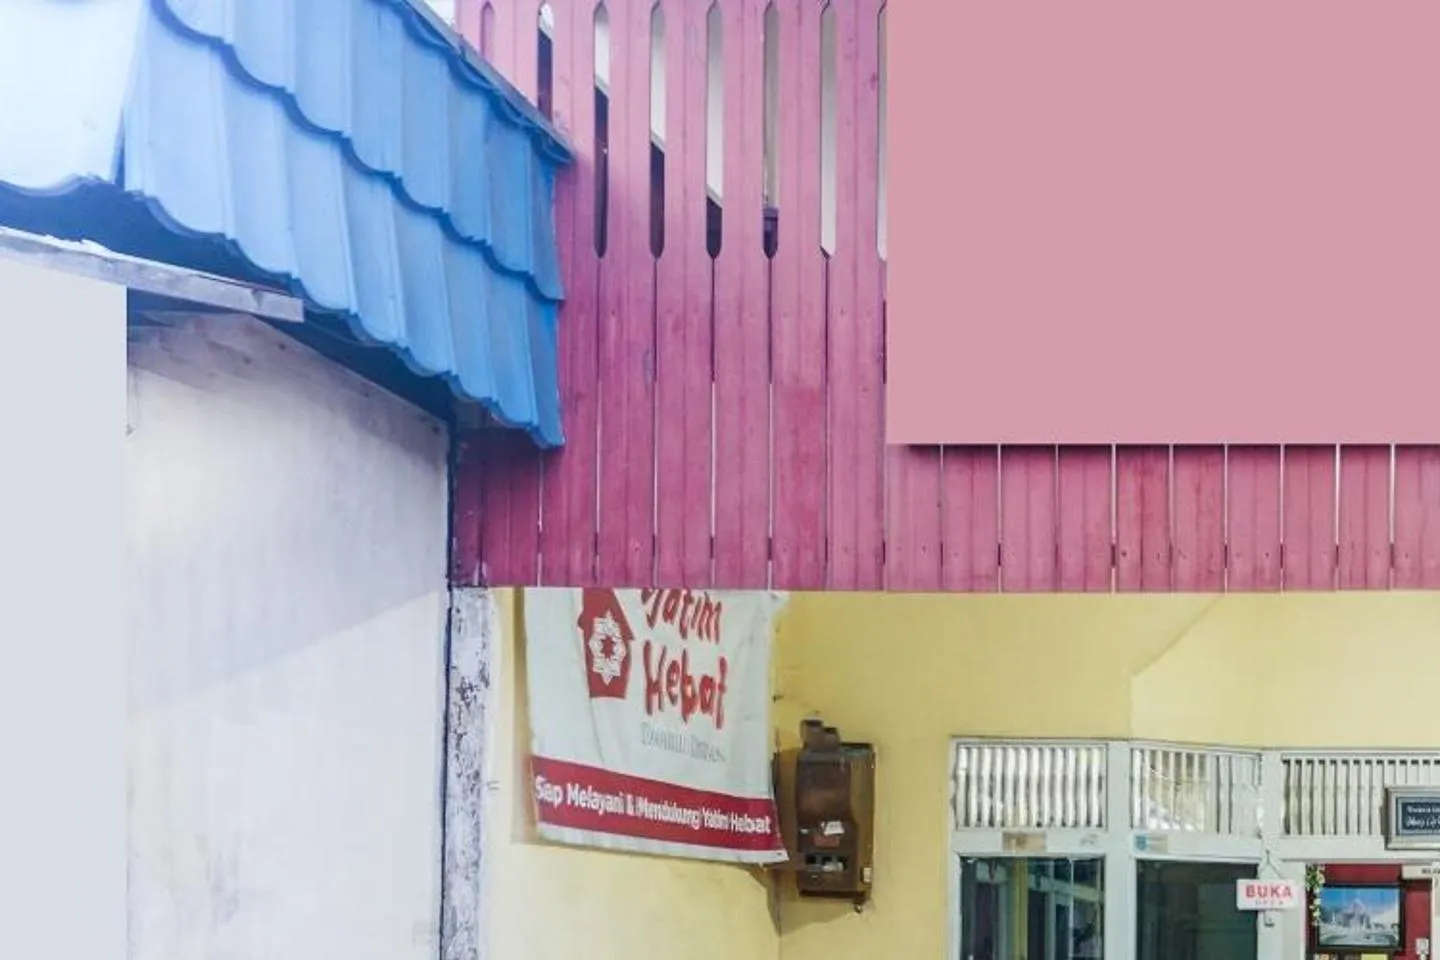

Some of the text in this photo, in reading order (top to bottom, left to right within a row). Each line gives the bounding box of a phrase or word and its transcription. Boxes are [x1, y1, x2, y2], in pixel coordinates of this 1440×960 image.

[642, 640, 728, 730] Hebat
[566, 782, 624, 816] Melayani
[731, 812, 771, 835] Hebat
[1245, 884, 1292, 898] BUKA
